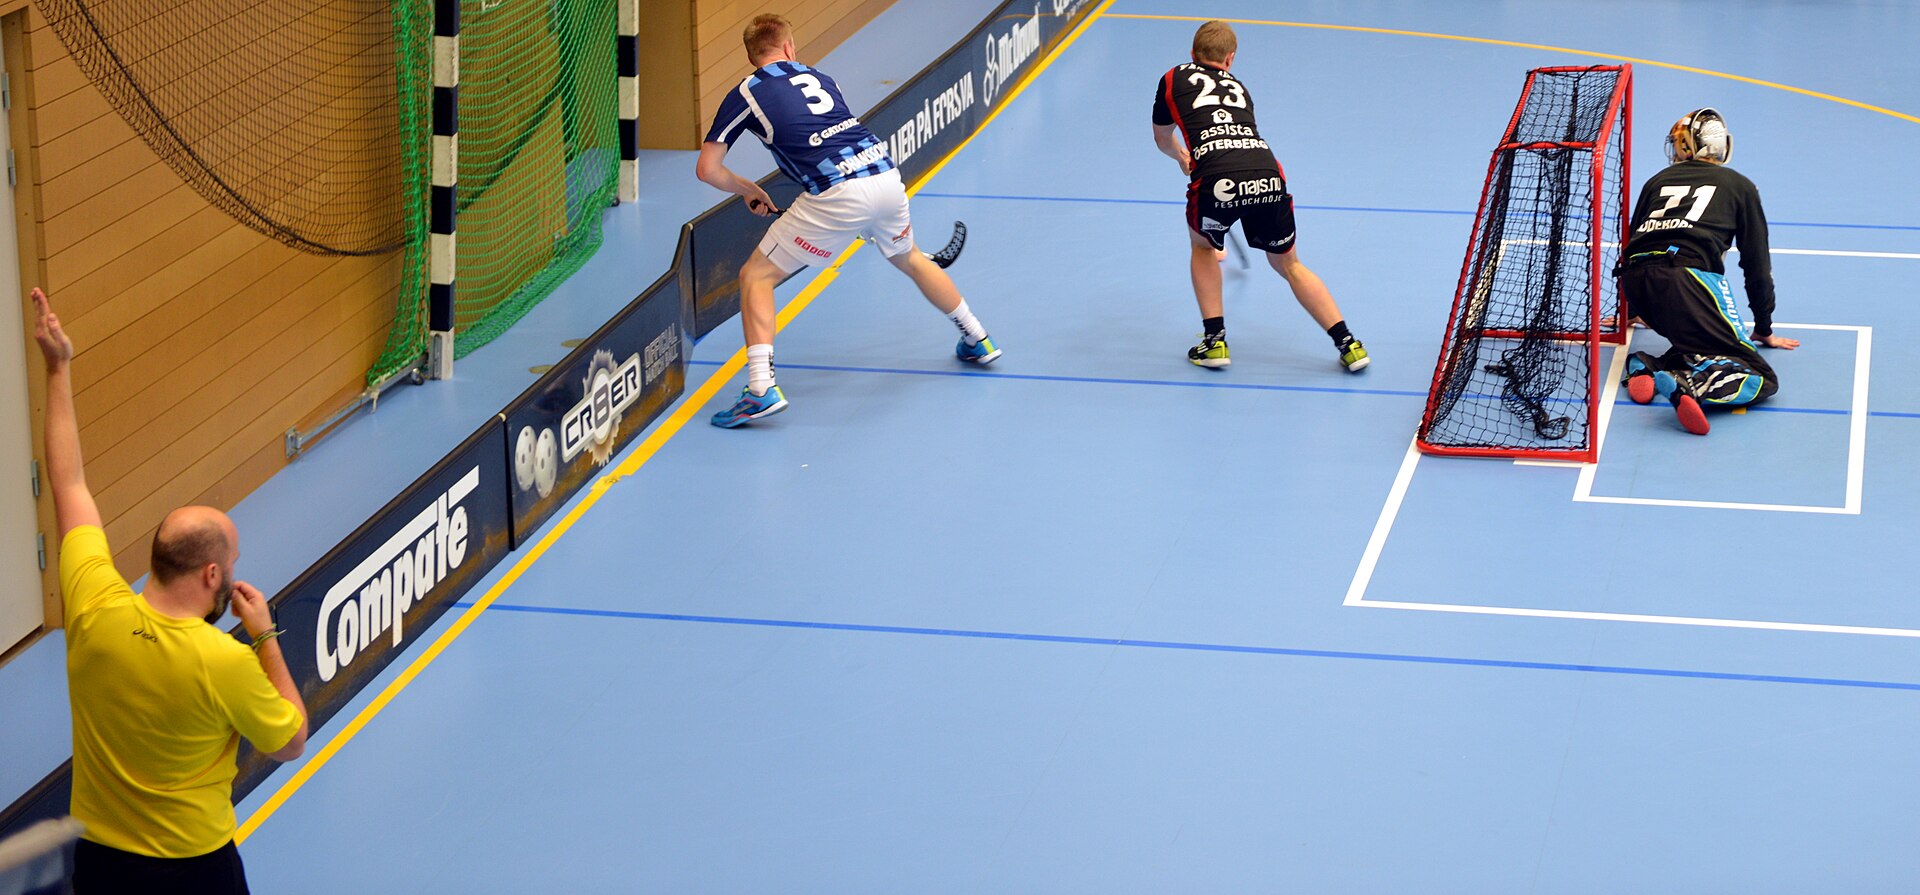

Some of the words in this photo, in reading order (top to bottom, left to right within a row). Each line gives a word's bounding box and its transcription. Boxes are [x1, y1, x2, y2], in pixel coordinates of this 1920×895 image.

[789, 73, 834, 115] 3
[1188, 72, 1247, 109] 23
[916, 98, 932, 149] PÅ
[1200, 124, 1254, 141] assista
[1193, 138, 1269, 161] ÖSTERBERG
[1214, 200, 1239, 209] FEST
[1241, 197, 1260, 206] OCH
[1649, 185, 1717, 222] 71
[566, 365, 638, 450] CR8ER
[316, 464, 479, 682] Compate
